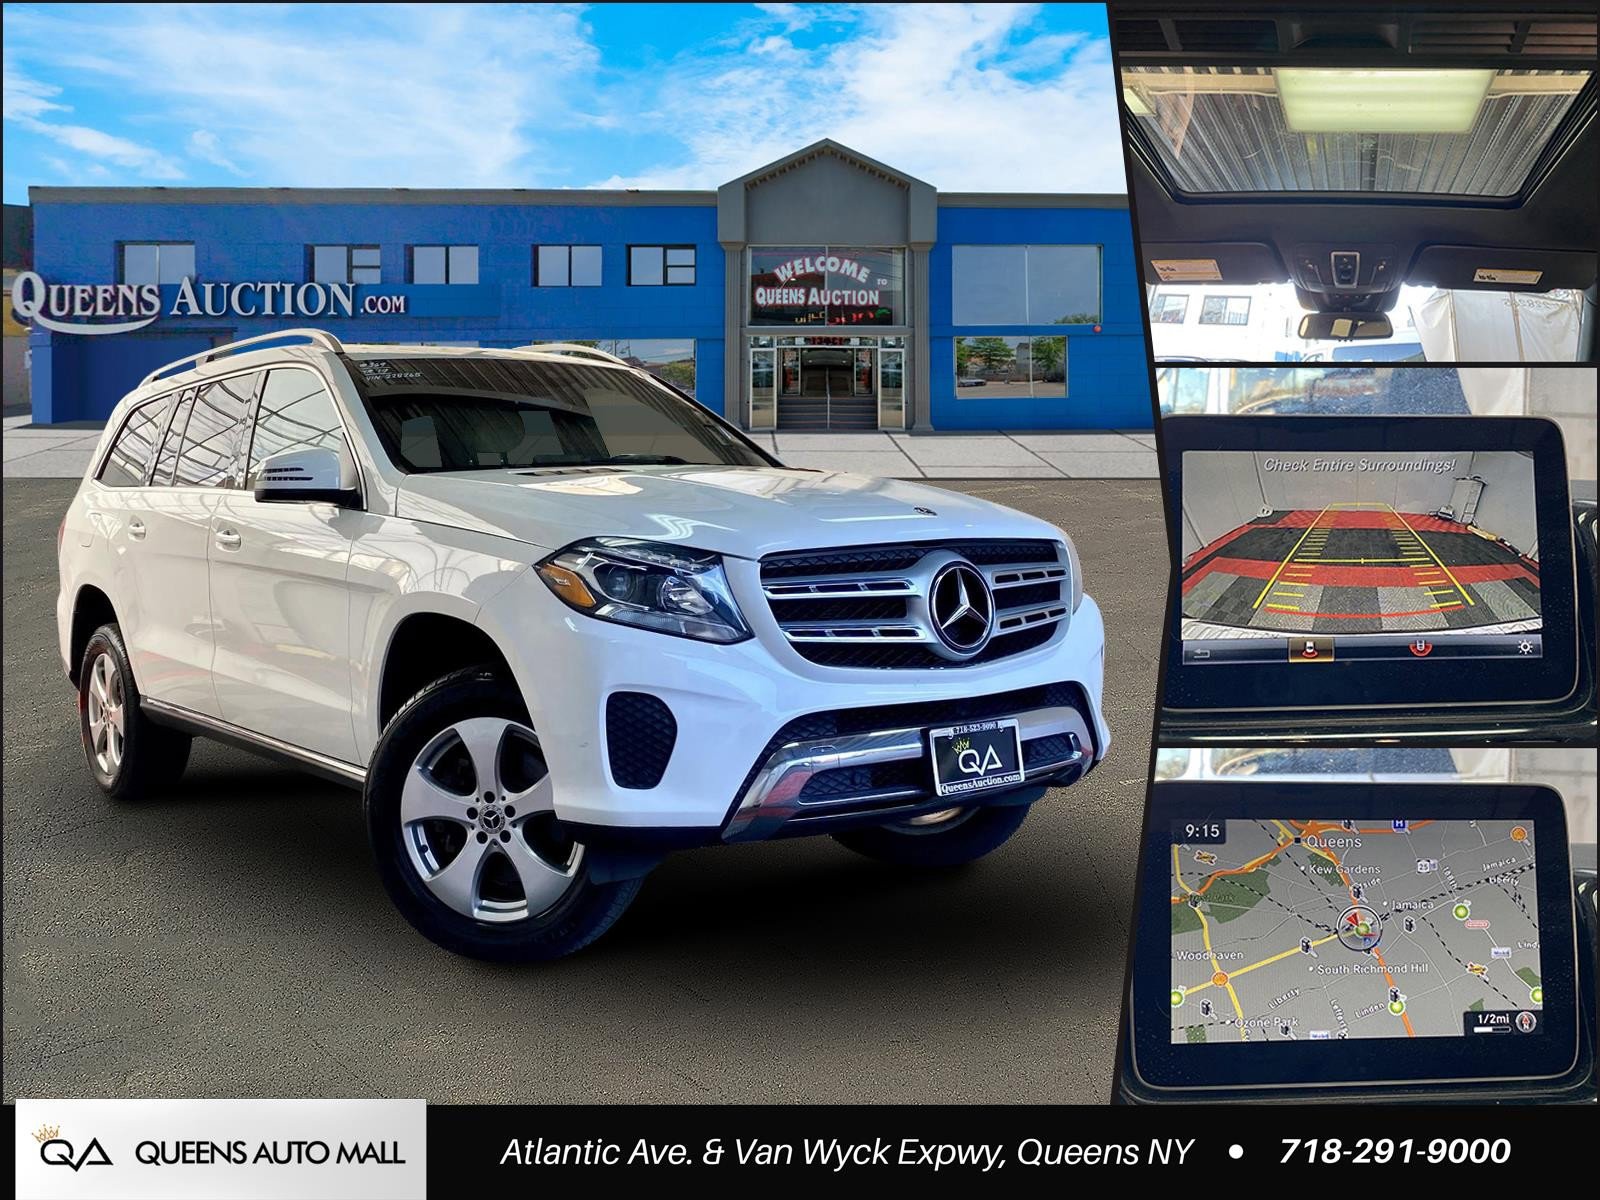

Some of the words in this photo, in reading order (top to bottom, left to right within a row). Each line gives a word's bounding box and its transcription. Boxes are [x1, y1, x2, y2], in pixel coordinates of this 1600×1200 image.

[774, 256, 871, 283] WELCOME
[13, 271, 161, 335] QUEENS
[755, 287, 806, 306] QUEENS
[808, 287, 879, 305] AUCTION
[1264, 458, 1309, 472] Check
[1313, 458, 1355, 472] Entire
[1358, 458, 1456, 474] Surroundings!
[941, 773, 1021, 794] QueensAuction.com
[1185, 823, 1220, 838] 9:15
[1307, 835, 1361, 848] Queens
[1309, 864, 1333, 875] Kew
[1335, 864, 1381, 875] Gardens
[1482, 857, 1517, 872] Jamaica
[1391, 899, 1434, 911] Jamaica
[1176, 950, 1244, 961] Woodhaven
[1316, 964, 1350, 976] South
[1352, 964, 1408, 974] Richmond
[1411, 963, 1429, 973] Hill
[1267, 987, 1300, 1010] Liberty
[1355, 1002, 1385, 1018] Linden
[1234, 1017, 1271, 1028] Ozone
[1273, 1016, 1299, 1027] Park
[1478, 1013, 1510, 1025] 1/2mi
